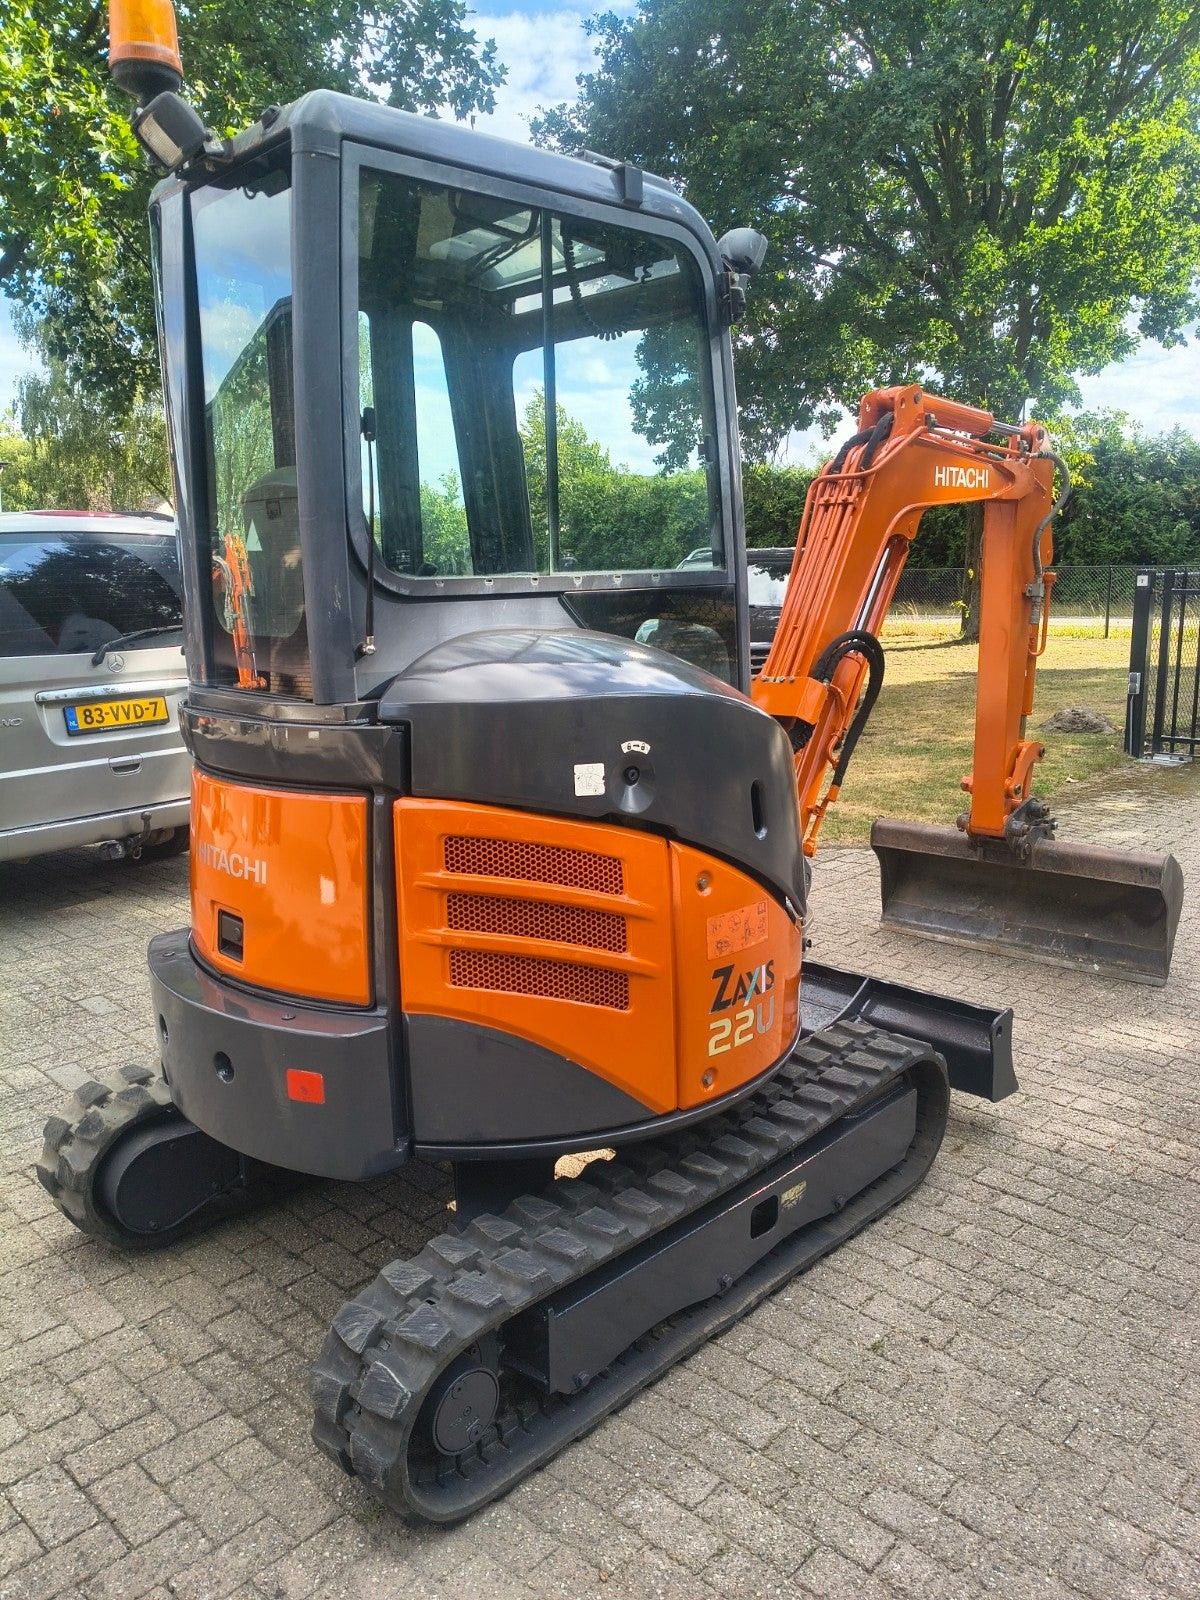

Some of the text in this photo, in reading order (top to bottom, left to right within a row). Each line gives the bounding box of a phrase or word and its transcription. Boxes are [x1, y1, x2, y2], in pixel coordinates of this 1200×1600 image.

[934, 465, 989, 488] HITACHI
[83, 701, 158, 725] 83-VVD-7
[199, 842, 267, 885] HITACHI
[710, 959, 775, 1014] ZAXIS
[708, 995, 775, 1057] 22U
